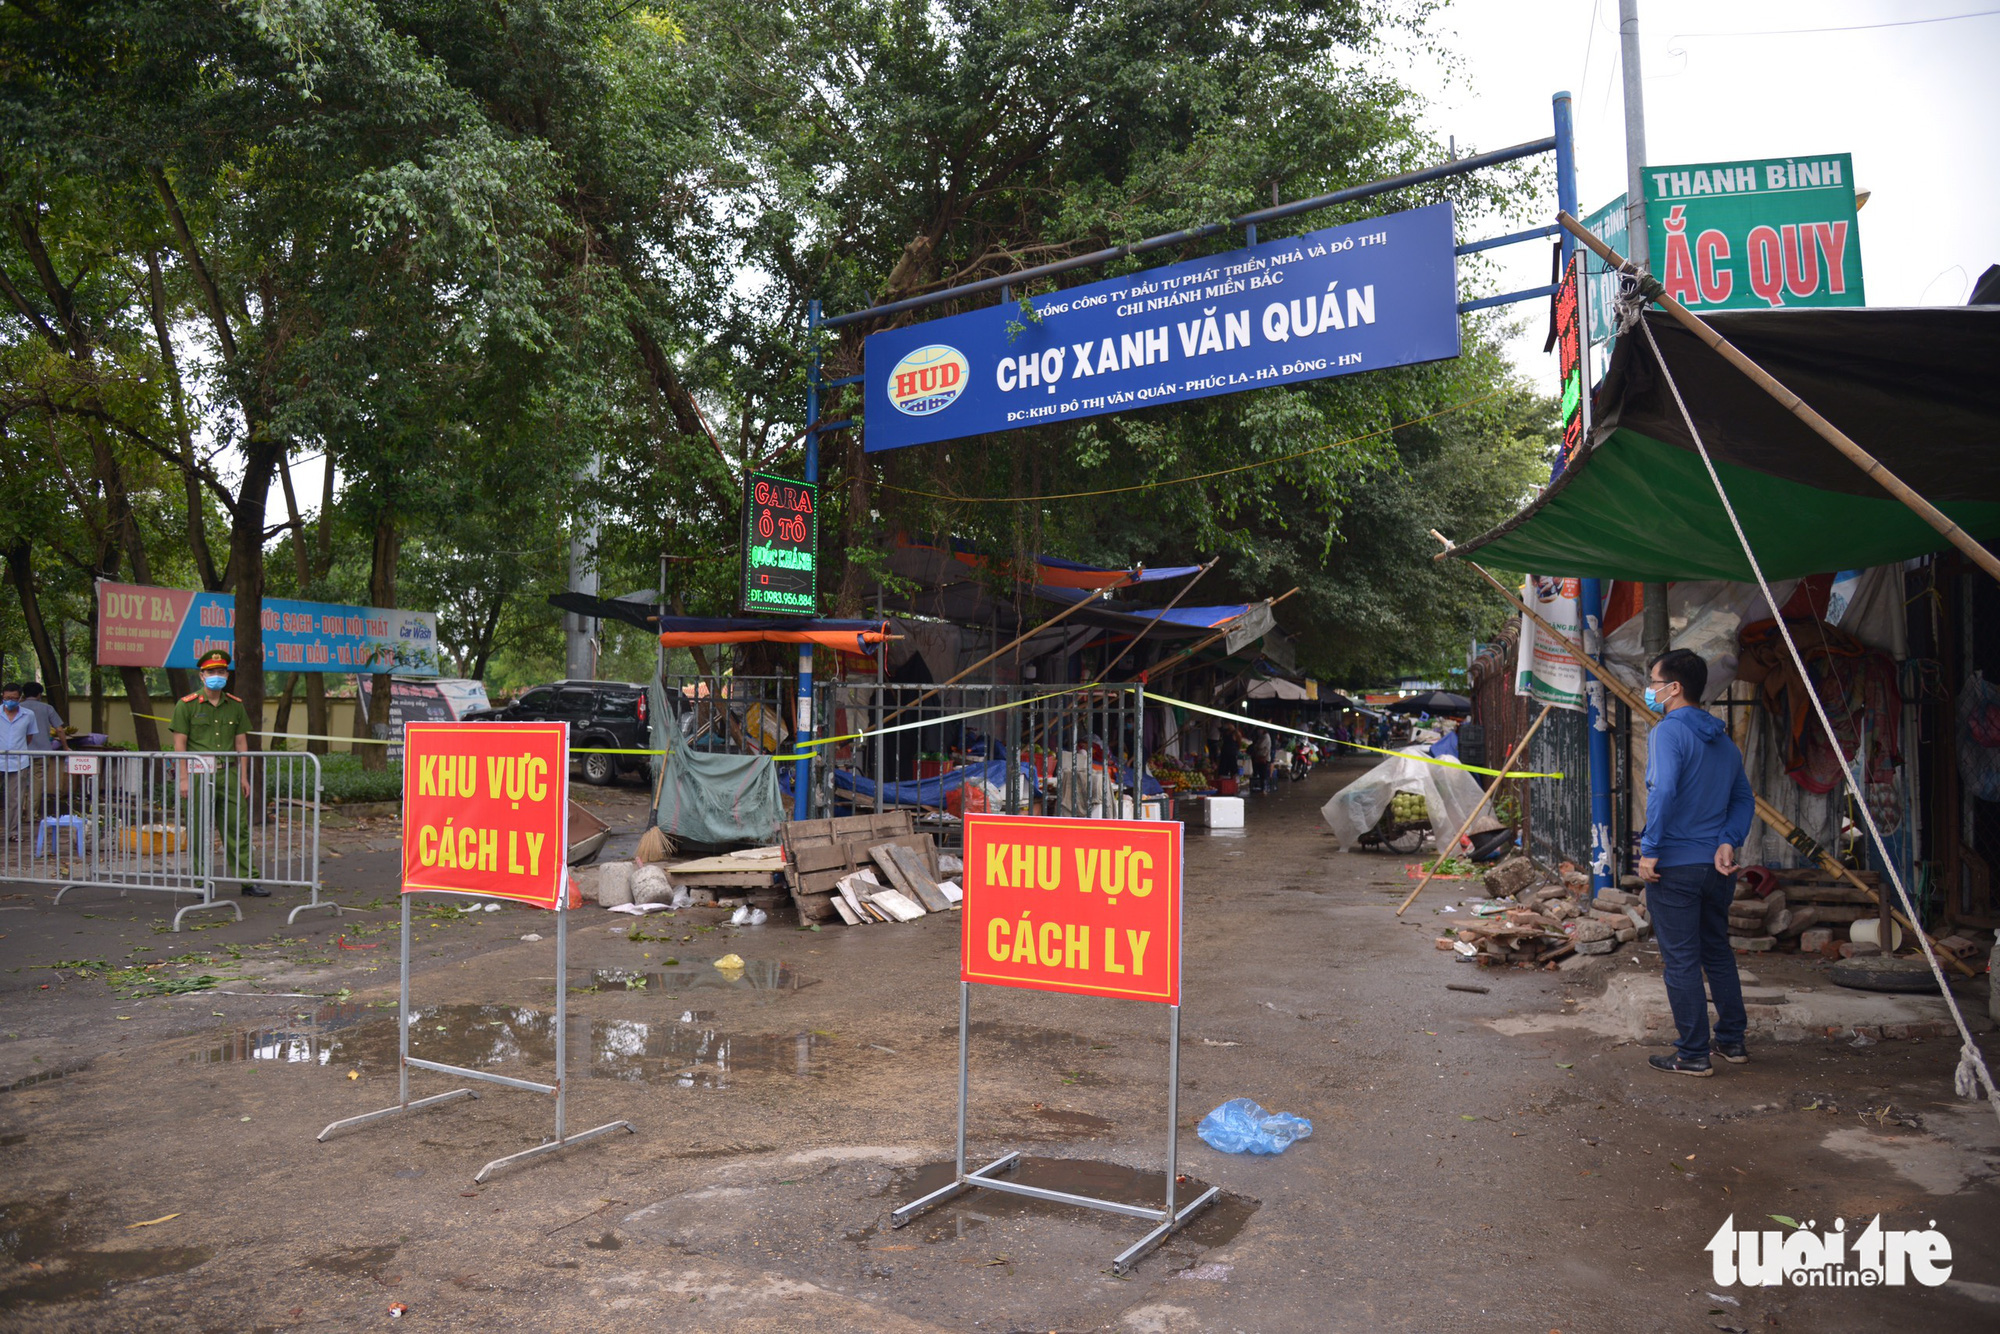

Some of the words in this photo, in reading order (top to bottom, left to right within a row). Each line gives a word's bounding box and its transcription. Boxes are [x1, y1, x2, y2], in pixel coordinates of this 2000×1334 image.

[1652, 167, 1756, 197] THANH
[1766, 160, 1842, 190] BÌNH
[1036, 302, 1069, 318] TỔNG
[1072, 296, 1108, 310] CÔNG
[1110, 290, 1128, 302] TY
[1131, 281, 1159, 297] ĐẦU
[1162, 277, 1181, 290] TƯ
[1183, 267, 1220, 286] PHÁT
[1224, 257, 1266, 277] TRIỂN
[1271, 248, 1304, 266] NHÀ
[1308, 243, 1327, 258] VÀ
[1331, 237, 1354, 254] ĐÔ
[1358, 232, 1387, 247] THỊ
[1662, 205, 1733, 305] ẮC
[1746, 220, 1849, 307] QUY
[1117, 302, 1143, 317] CHI
[1147, 289, 1202, 311] NHÁNH
[1206, 277, 1245, 298] MIỀN
[1250, 268, 1284, 290] BẮC
[996, 346, 1066, 394] CHỢ
[1071, 325, 1169, 379] XANH
[1177, 306, 1250, 358] VĂN
[1262, 281, 1376, 343] QUÁN
[895, 362, 961, 398] HUD
[1060, 399, 1080, 414] ĐÔ
[1082, 395, 1105, 411] THỊ
[1107, 390, 1135, 406] VĂN
[1137, 383, 1176, 400] QUÁN
[1186, 374, 1226, 392] PHÚC
[1282, 359, 1327, 375] ĐÔNG
[1338, 352, 1363, 367] HN
[755, 481, 813, 513] GARA
[759, 508, 775, 538] Ô
[778, 514, 807, 542] TÔ
[751, 539, 778, 568] QUỐC
[778, 546, 812, 571] KHÁNH
[106, 593, 147, 620] DUY
[151, 597, 175, 622] BA
[200, 600, 226, 628] RỬA
[283, 611, 313, 637] SẠCH
[322, 615, 344, 639] DỌN
[346, 614, 364, 640] NỘI
[366, 614, 389, 638] THẤT
[276, 642, 304, 663] THAY
[306, 638, 329, 664] DẦU
[338, 642, 352, 665] VÁ
[400, 625, 412, 638] Car
[413, 626, 432, 640] Wash
[74, 763, 91, 771] STOP
[419, 755, 477, 798] KHU
[486, 752, 548, 810] VỰC
[419, 817, 498, 872] CÁCH
[508, 830, 545, 876] LY
[986, 843, 1061, 891] KHU
[1074, 845, 1154, 905] VỰC
[987, 910, 1090, 970] CÁCH
[1104, 927, 1151, 976] LY
